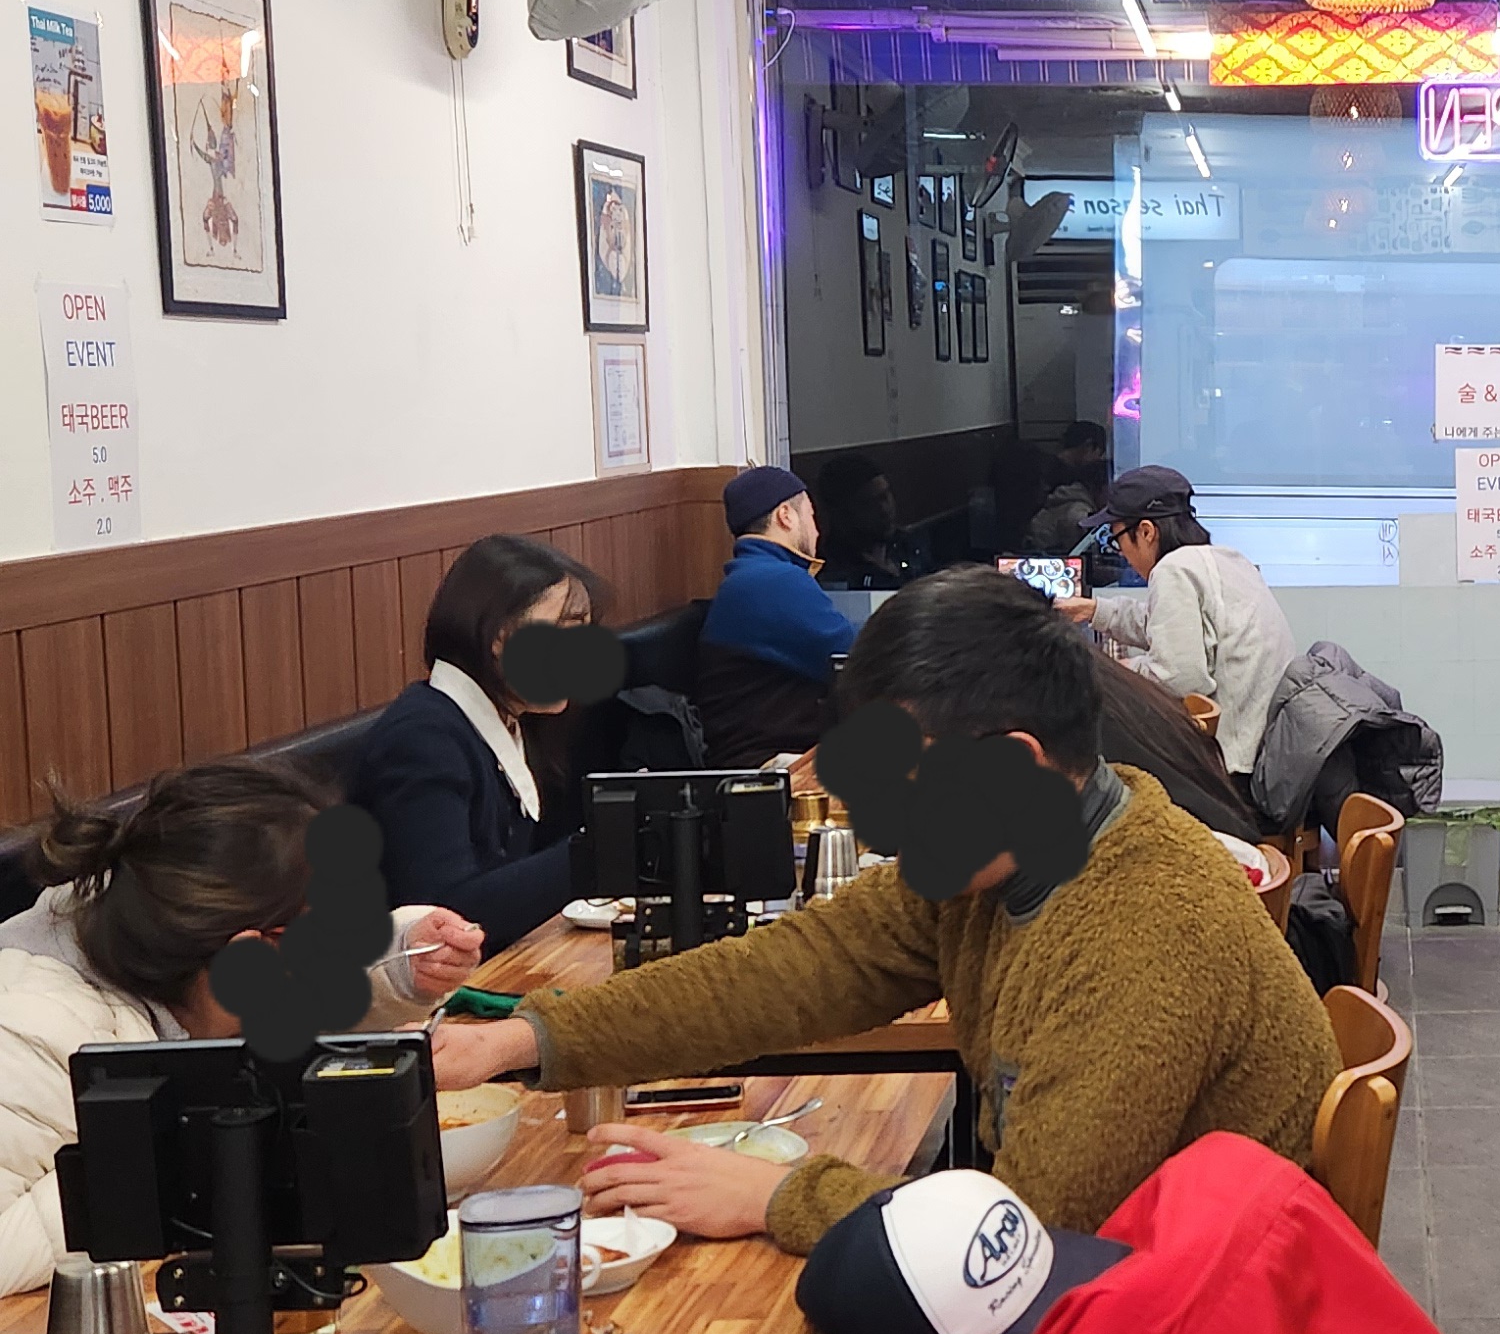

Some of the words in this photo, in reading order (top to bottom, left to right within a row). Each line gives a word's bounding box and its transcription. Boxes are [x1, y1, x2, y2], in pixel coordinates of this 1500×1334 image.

[31, 15, 45, 30] Thai
[47, 19, 61, 34] Milk
[61, 23, 73, 37] Tea
[88, 193, 111, 212] 5,000
[62, 293, 106, 321] OPEN
[66, 340, 116, 367] EVENT
[1458, 383, 1477, 404] 술
[1484, 384, 1498, 402] &
[61, 403, 129, 433] 태국BEER
[92, 446, 107, 463] 5.0
[68, 478, 96, 506] 소주
[108, 475, 133, 503] 맥주
[97, 517, 112, 535] 2.0
[1470, 544, 1497, 559] 소주
